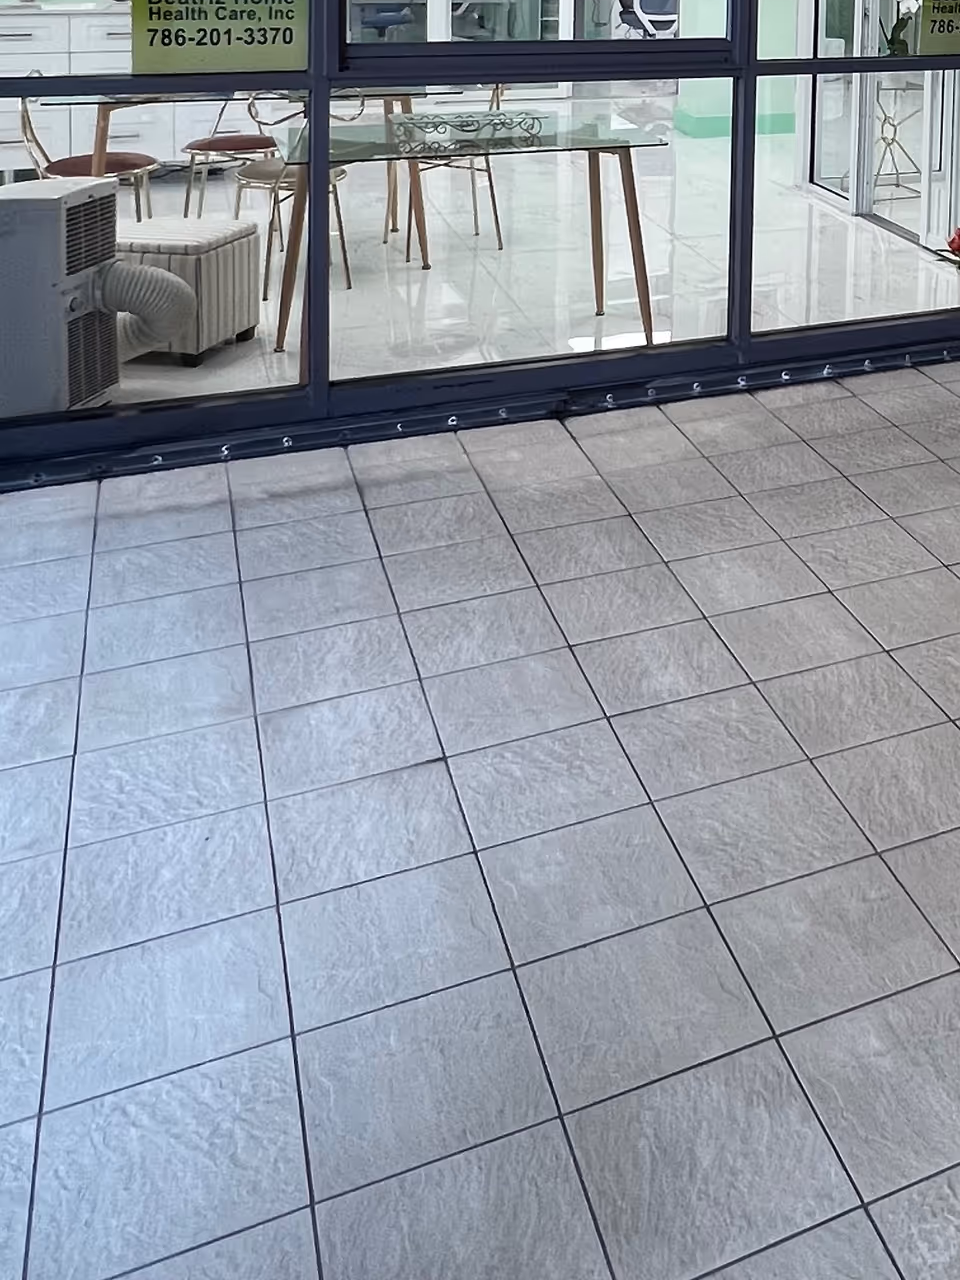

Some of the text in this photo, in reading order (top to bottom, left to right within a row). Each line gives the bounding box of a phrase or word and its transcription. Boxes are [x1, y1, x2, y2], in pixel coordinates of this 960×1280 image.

[148, 6, 295, 22] Health Care, Inc
[147, 27, 294, 47] 786-201-3370
